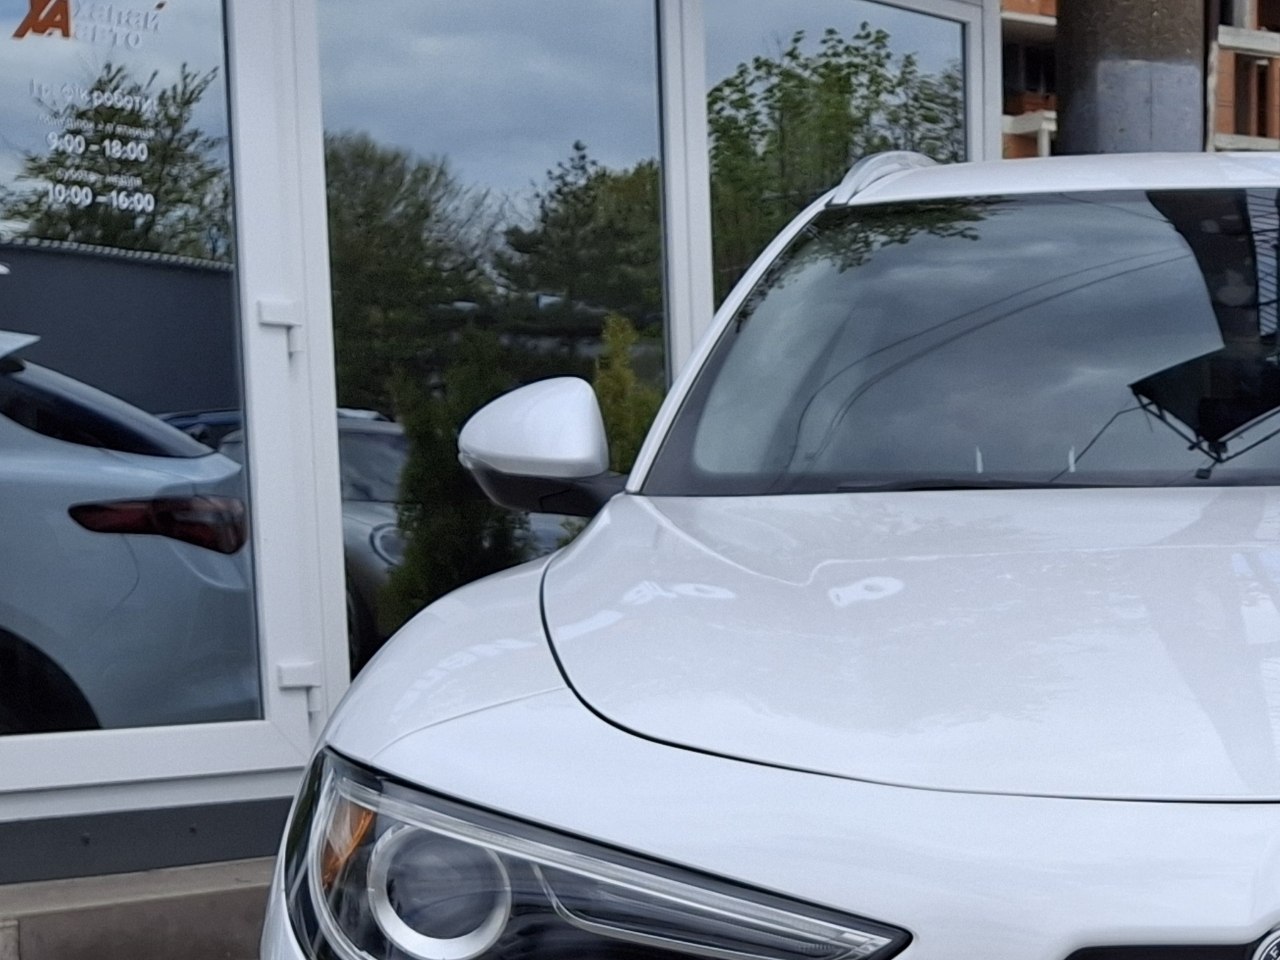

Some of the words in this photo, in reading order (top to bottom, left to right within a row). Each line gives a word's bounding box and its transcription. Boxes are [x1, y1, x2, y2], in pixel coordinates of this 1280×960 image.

[47, 131, 86, 155] 9:00
[103, 139, 149, 162] 18:00
[47, 184, 93, 206] 10:00
[110, 190, 155, 213] 16:00
